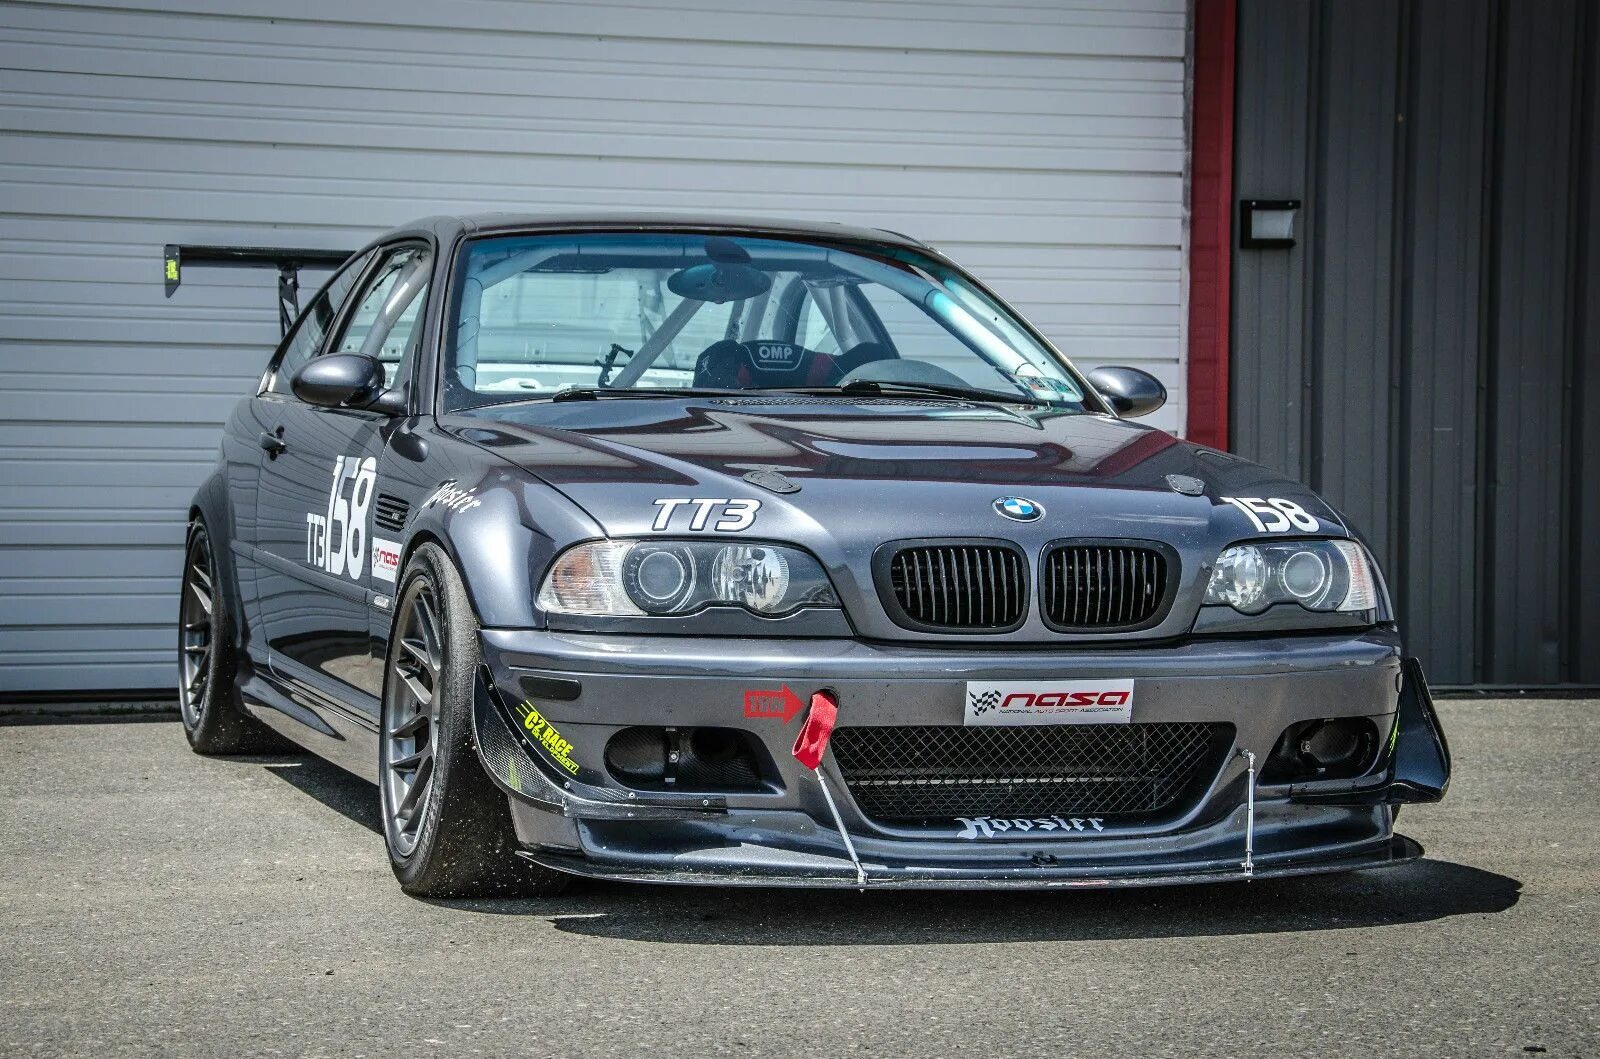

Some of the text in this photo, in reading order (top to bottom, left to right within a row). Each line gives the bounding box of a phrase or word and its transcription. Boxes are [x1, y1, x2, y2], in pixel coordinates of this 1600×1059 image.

[758, 345, 793, 360] OMP
[325, 454, 377, 580] 158
[652, 498, 763, 532] TT3
[1219, 496, 1320, 533] 158
[306, 512, 327, 568] TT3
[380, 550, 401, 567] nas
[524, 711, 575, 759] C2 RACE
[531, 727, 576, 771] DEVELOPMENT
[953, 815, 1105, 840] Hoosier
